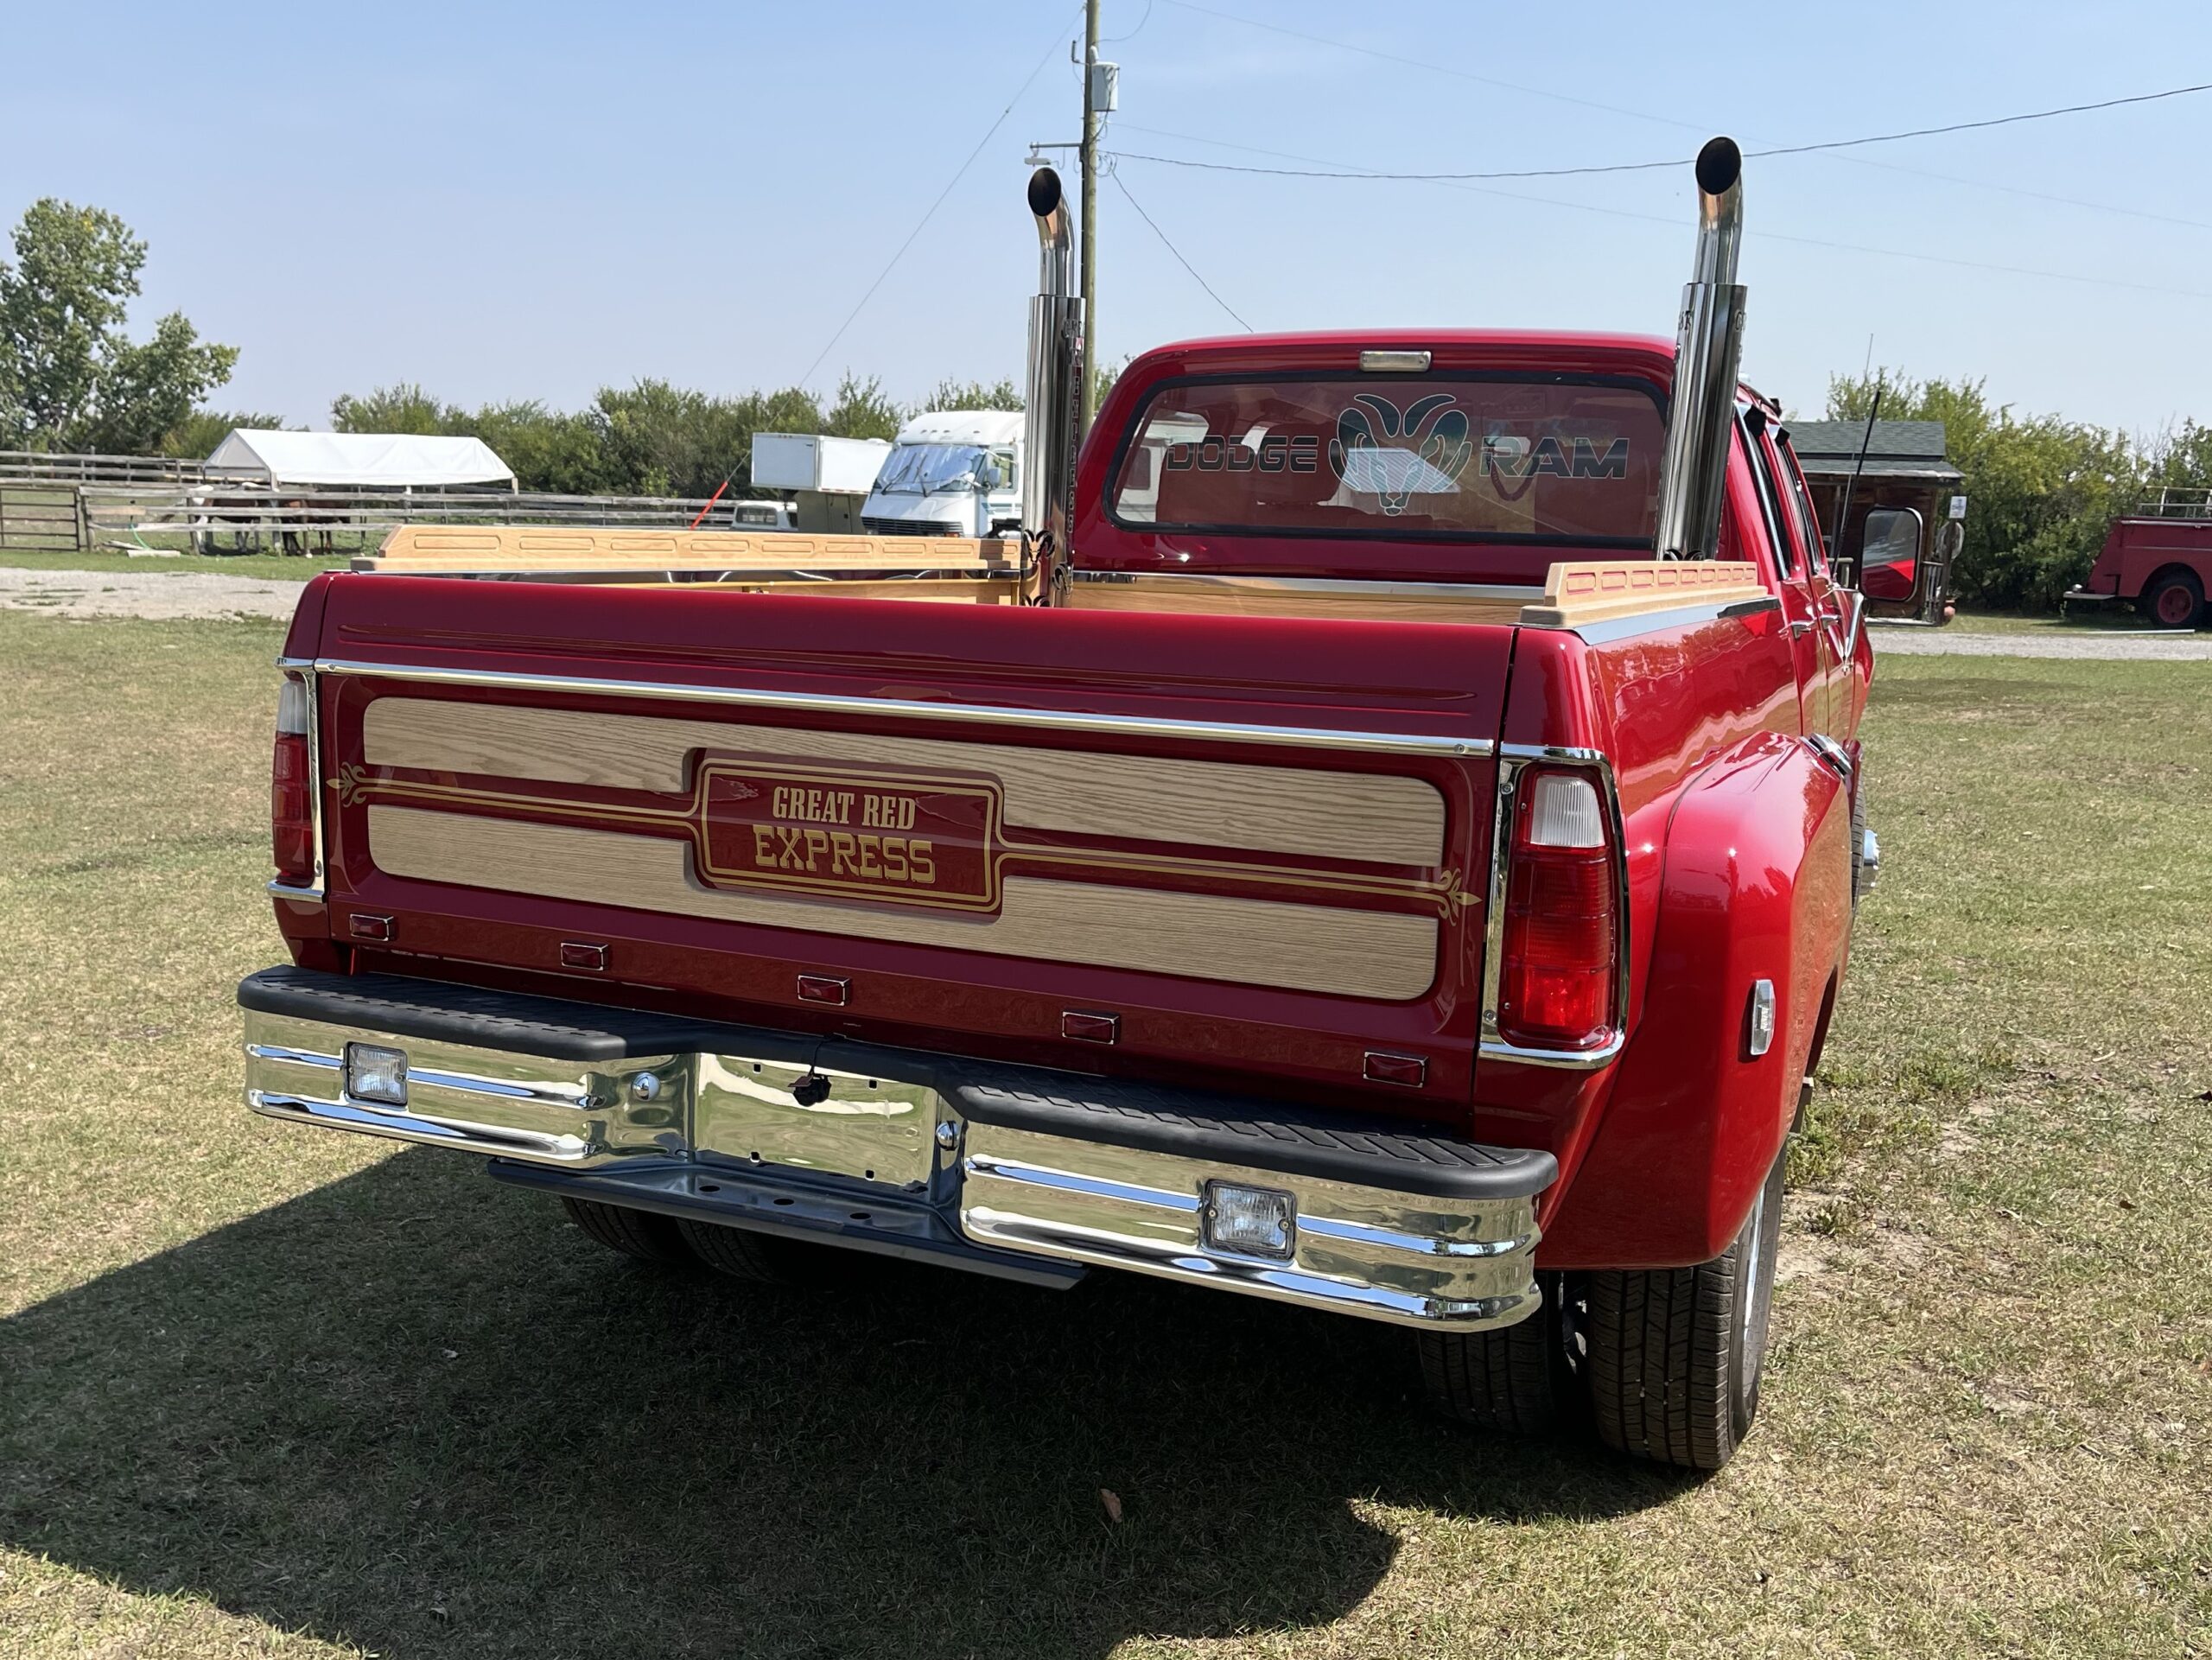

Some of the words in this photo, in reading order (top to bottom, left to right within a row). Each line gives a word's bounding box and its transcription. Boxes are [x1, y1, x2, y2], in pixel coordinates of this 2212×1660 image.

[1166, 435, 1319, 474] DODGE
[1479, 436, 1630, 480] RAM
[772, 786, 855, 824] GREAT
[861, 795, 916, 830] RED
[753, 824, 936, 884] EXPRESS
